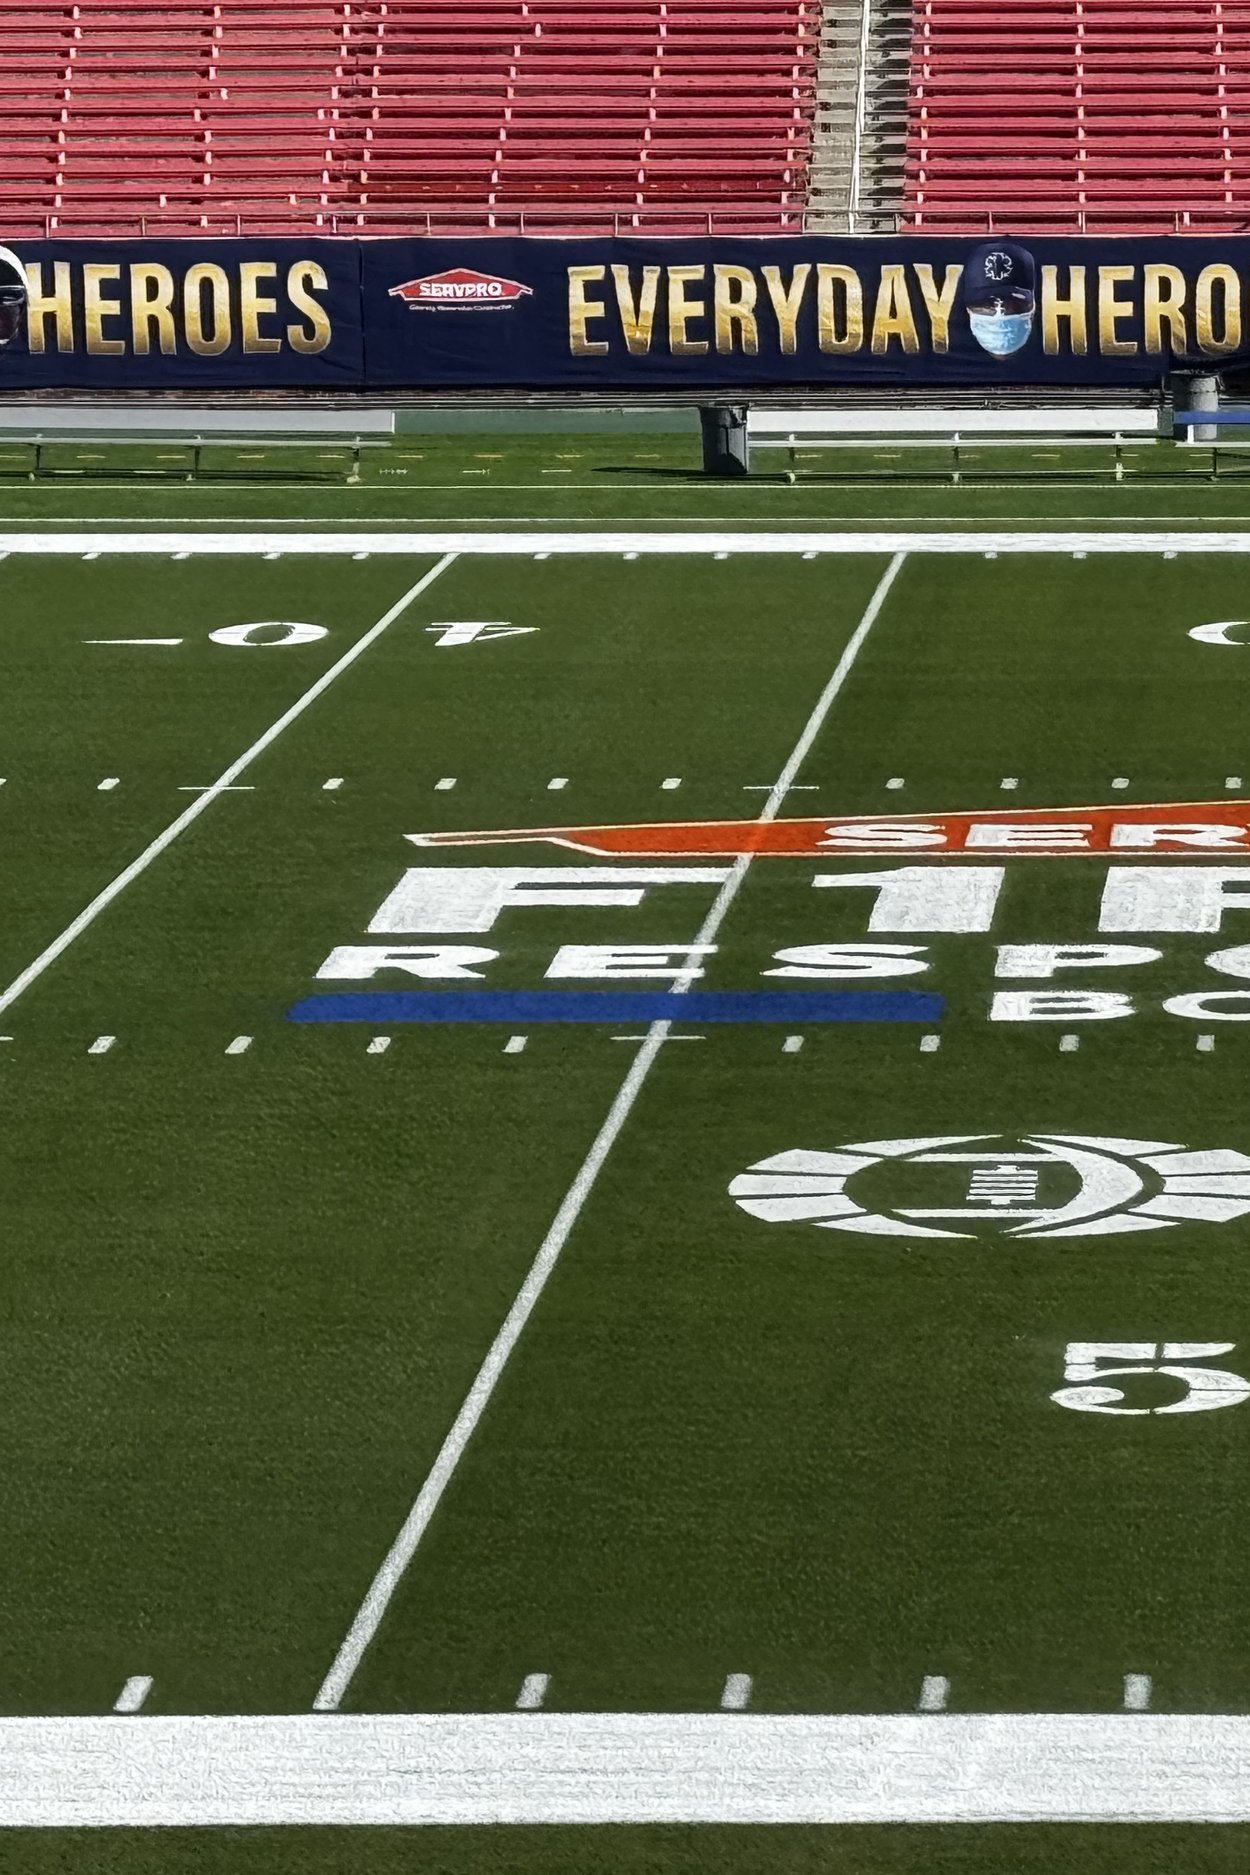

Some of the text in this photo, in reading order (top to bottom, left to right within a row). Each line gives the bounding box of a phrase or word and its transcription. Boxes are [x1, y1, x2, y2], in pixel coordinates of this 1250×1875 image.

[25, 260, 333, 357] HEROES
[419, 282, 502, 297] SERVPRO
[567, 264, 964, 356] EVERYDAY
